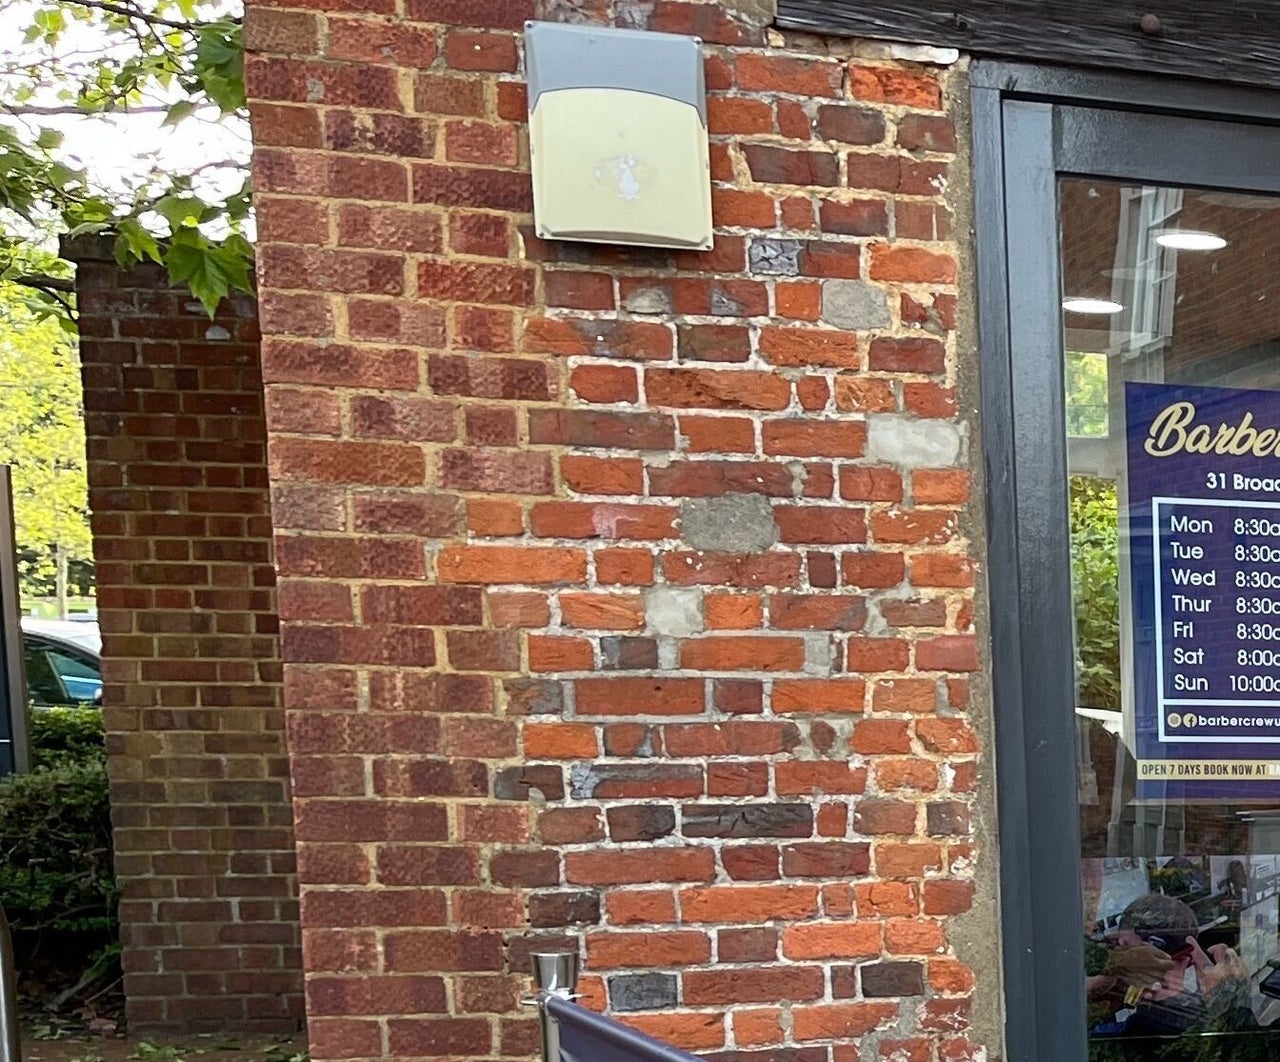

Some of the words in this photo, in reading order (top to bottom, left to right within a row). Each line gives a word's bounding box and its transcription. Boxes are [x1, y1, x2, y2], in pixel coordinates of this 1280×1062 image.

[1206, 472, 1226, 489] 31
[1170, 516, 1213, 533] Mon
[1170, 542, 1204, 560] Tue
[1171, 569, 1216, 586] Wed
[1172, 595, 1211, 613] Thur
[1174, 621, 1193, 638] Fri
[1174, 648, 1204, 665] Sat
[1174, 674, 1209, 691] Sun
[1141, 764, 1167, 775] OPEN
[1169, 764, 1175, 775] 7
[1178, 764, 1201, 775] DAYS
[1203, 764, 1229, 775] BOOK
[1231, 764, 1253, 775] NOW
[1255, 764, 1266, 775] AT
